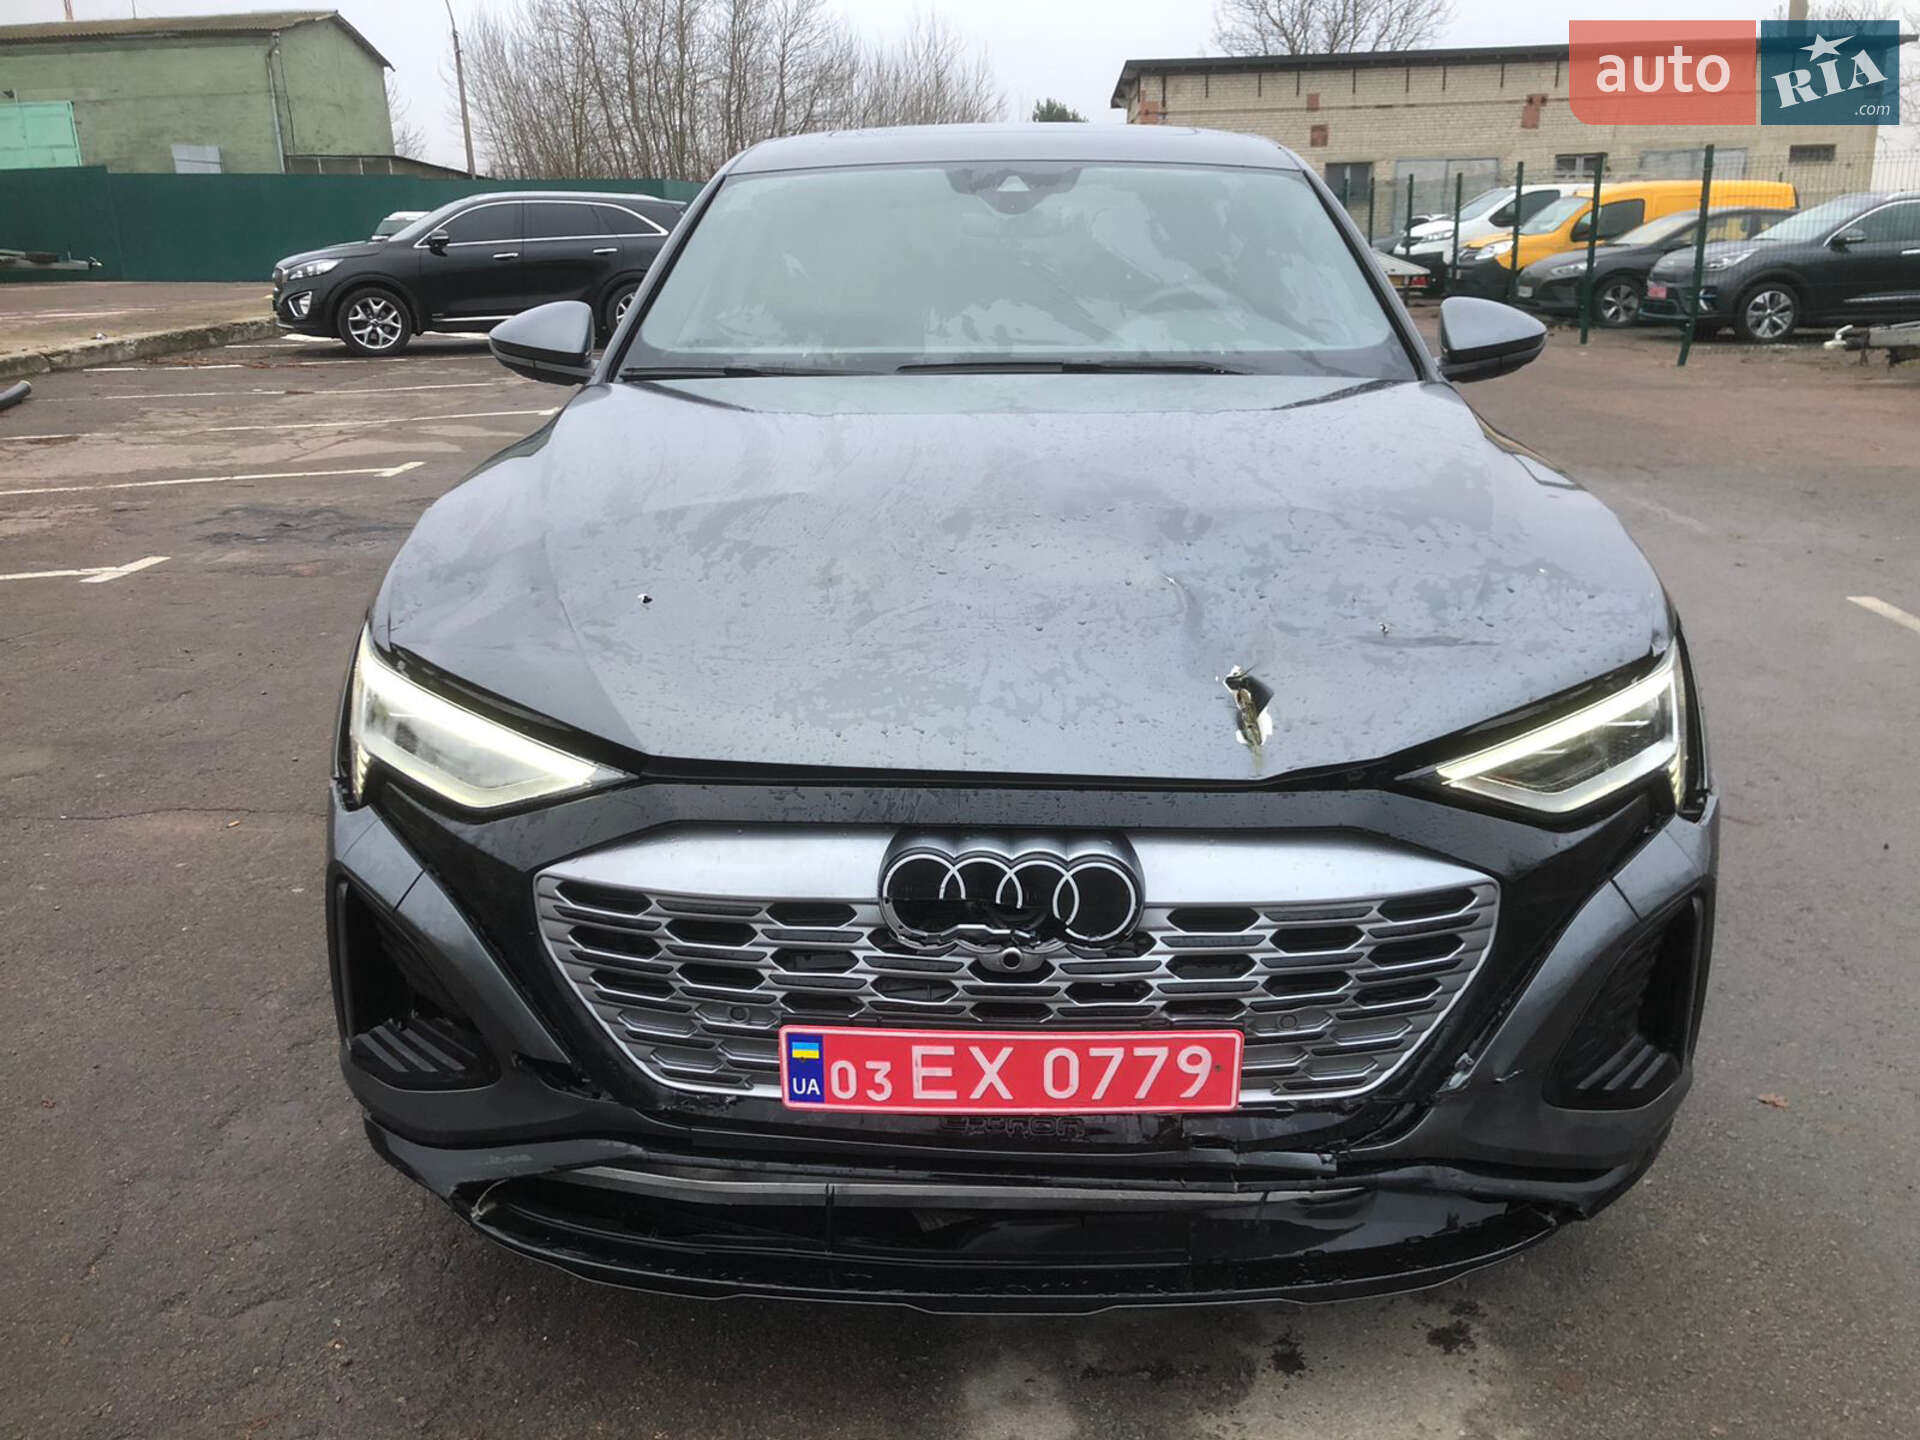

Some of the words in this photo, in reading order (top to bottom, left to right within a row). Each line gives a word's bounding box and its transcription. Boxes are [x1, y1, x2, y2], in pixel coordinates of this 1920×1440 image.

[792, 1078, 821, 1096] UA
[830, 1060, 893, 1101] 03
[911, 1045, 1014, 1100] EX
[1043, 1045, 1212, 1100] 0779
